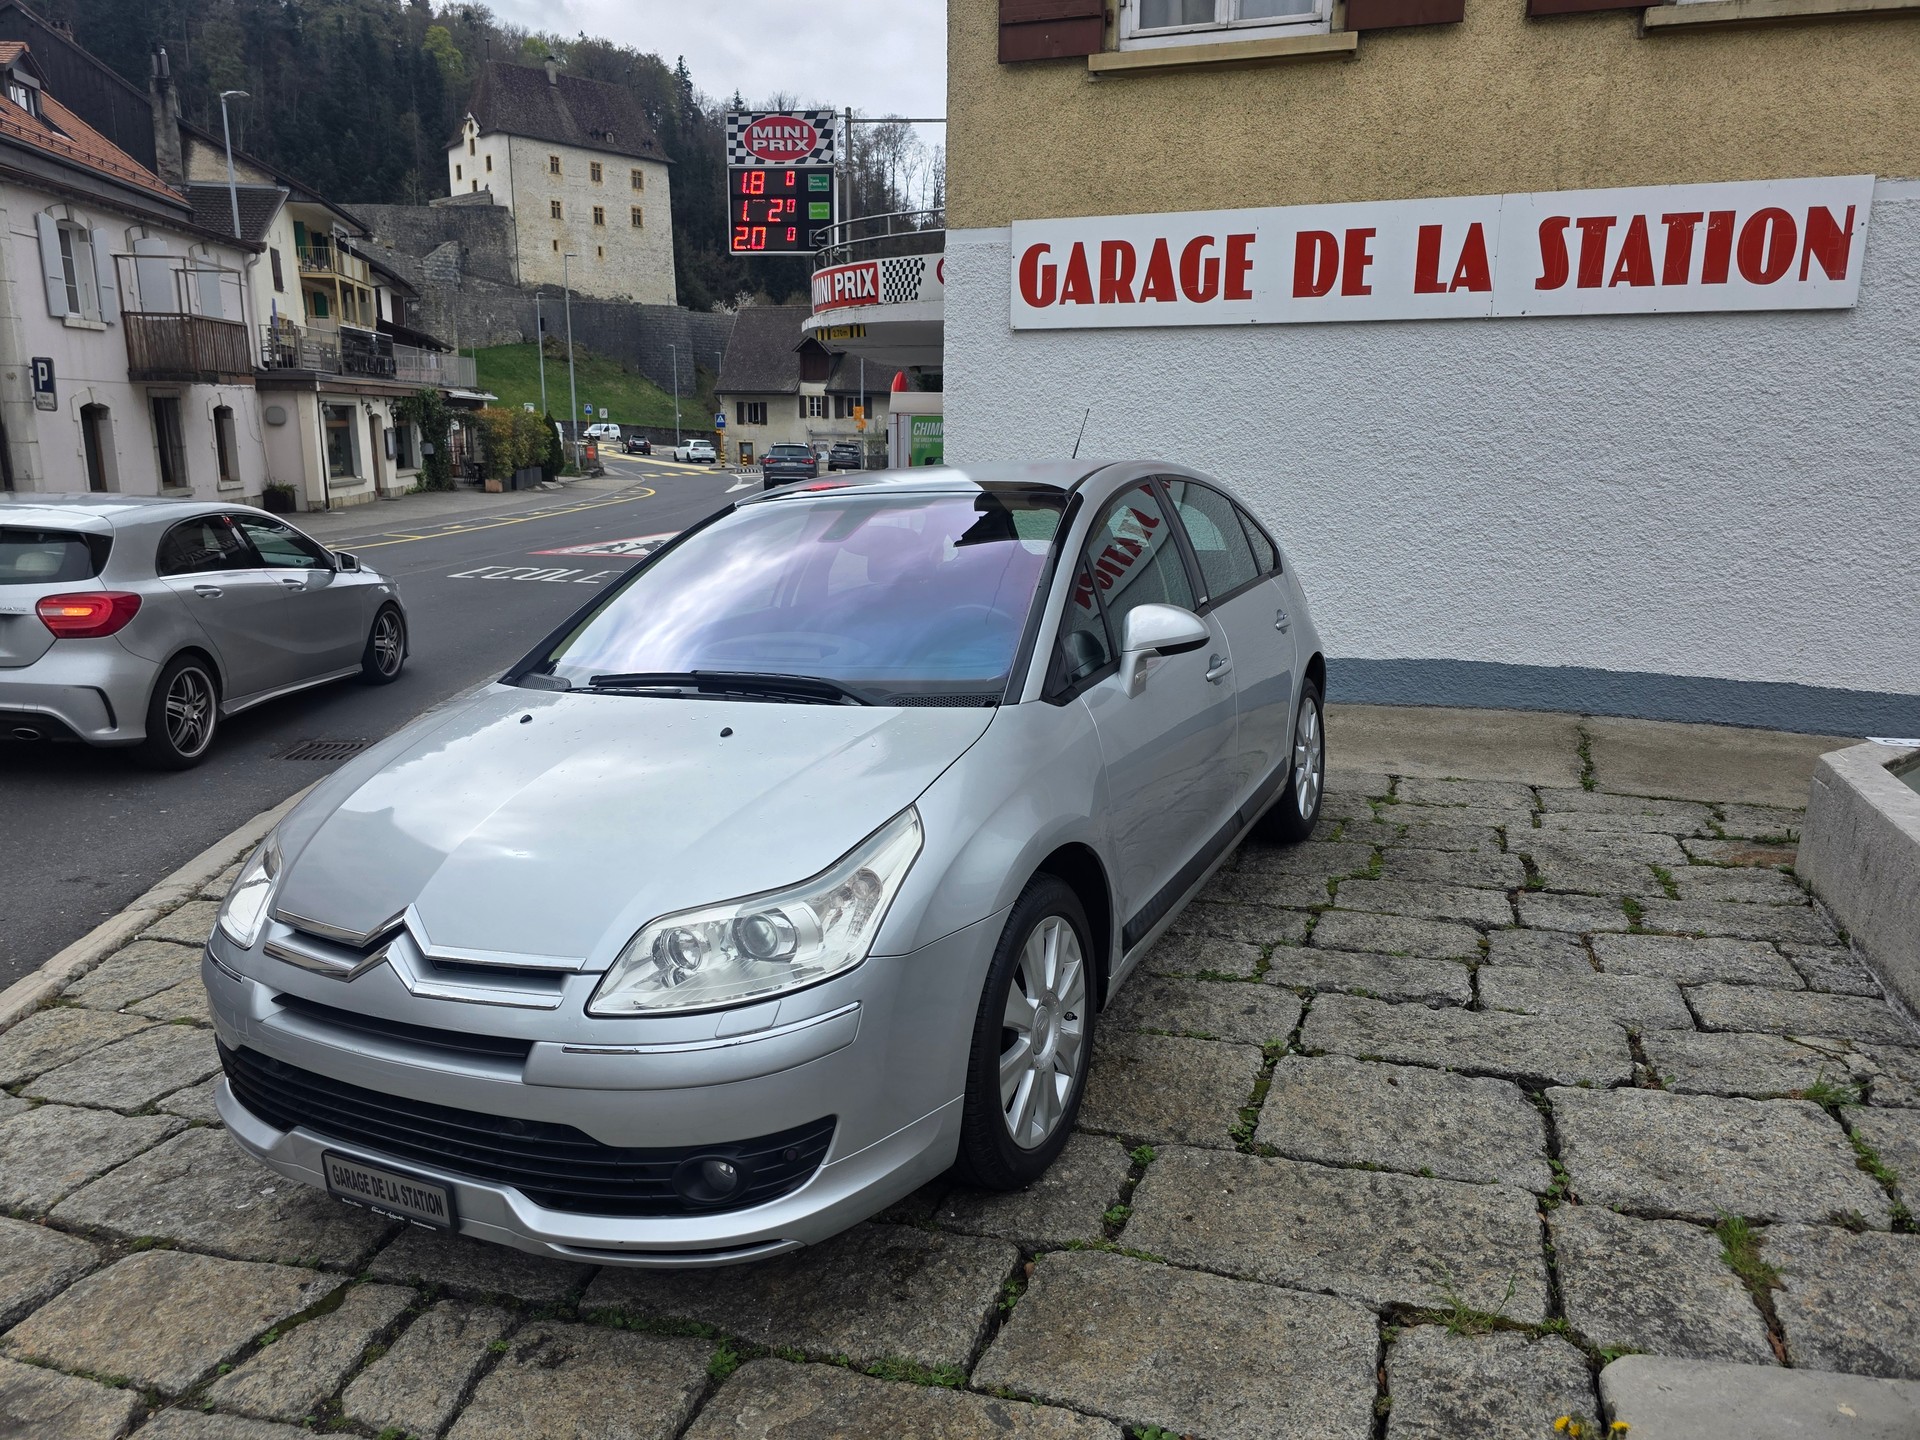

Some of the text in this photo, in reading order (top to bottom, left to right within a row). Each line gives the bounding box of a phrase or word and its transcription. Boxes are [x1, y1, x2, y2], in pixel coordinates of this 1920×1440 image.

[752, 126, 809, 138] MINI
[752, 139, 810, 151] PRIX
[1018, 204, 1857, 309] GARAGE DE LA STATION
[813, 267, 876, 306] MINI PRIX
[37, 362, 49, 390] P
[447, 566, 625, 584] ECOLE
[332, 1164, 371, 1195] GARAGE
[371, 1176, 386, 1200] DE
[386, 1180, 401, 1204] LA
[401, 1185, 444, 1217] STATION
